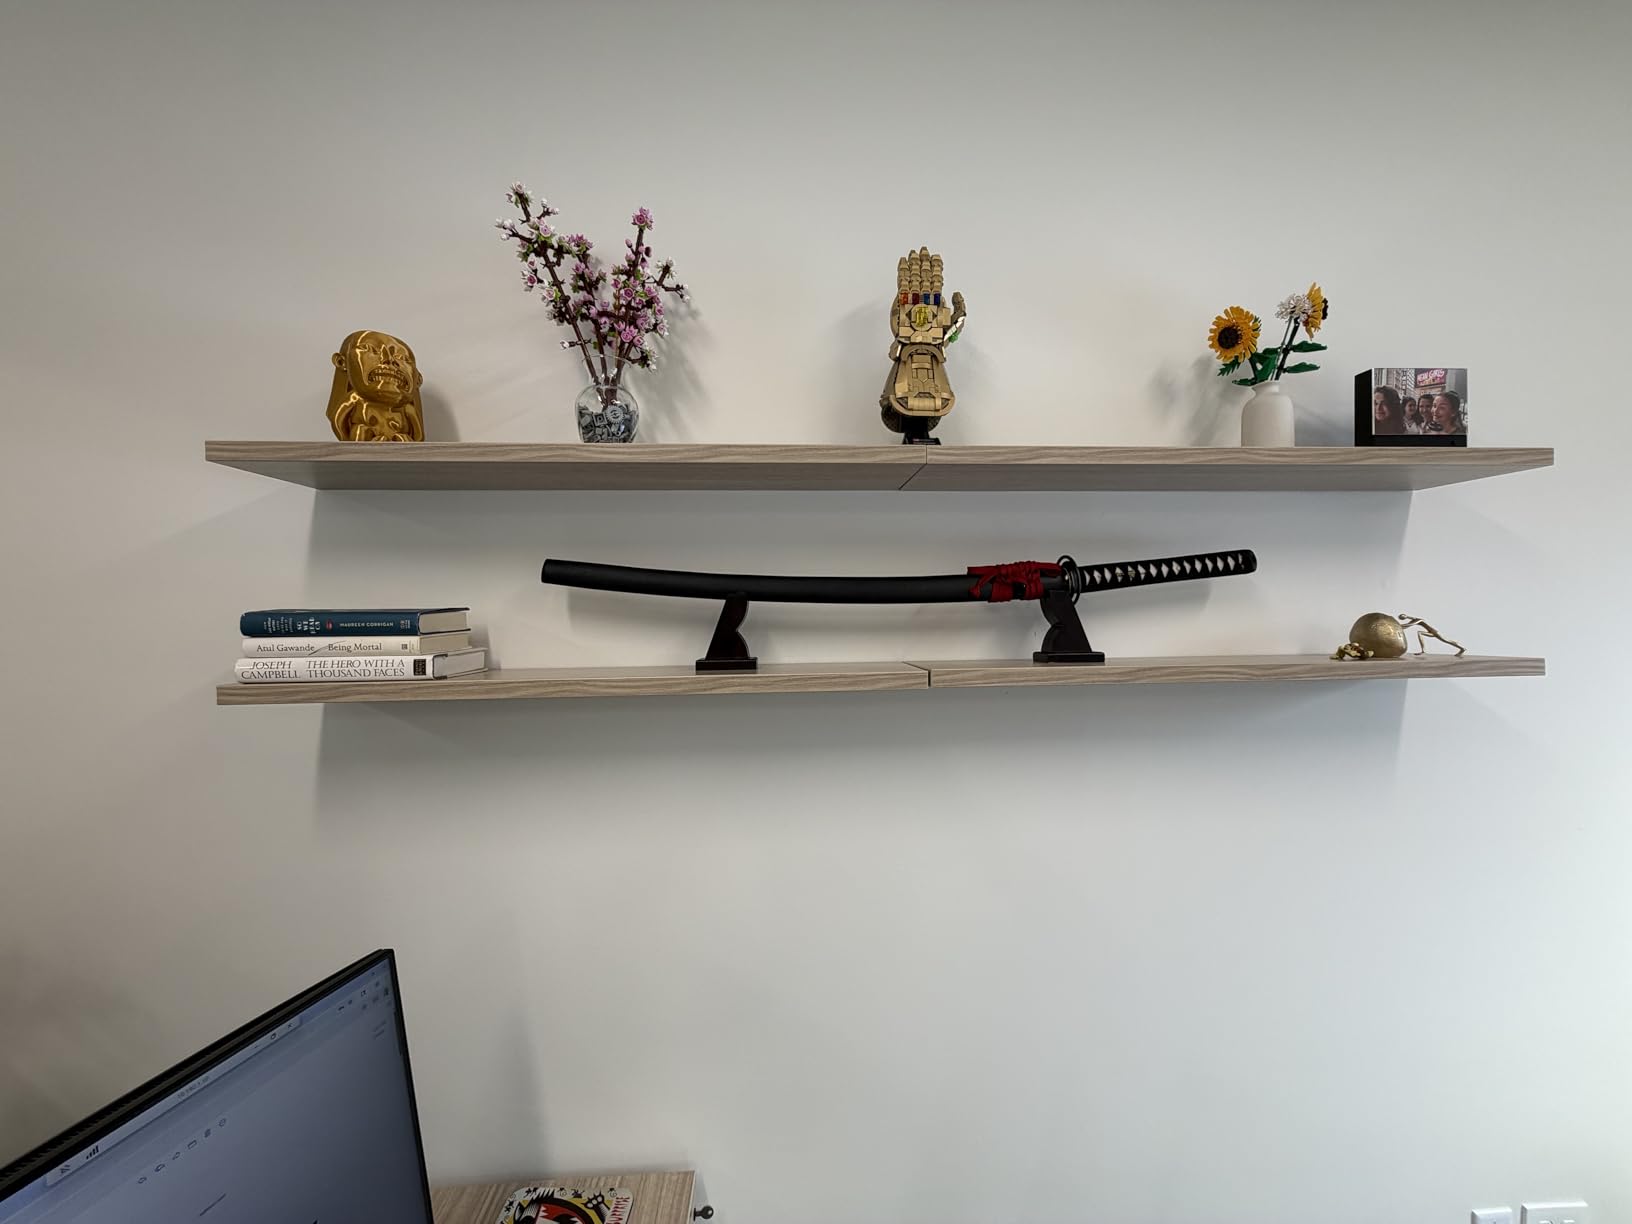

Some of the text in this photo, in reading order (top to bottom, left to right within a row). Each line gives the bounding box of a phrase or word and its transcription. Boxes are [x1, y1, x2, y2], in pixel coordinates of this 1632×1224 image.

[256, 643, 315, 652] Atul Gawande
[328, 642, 382, 652] Being Mortal
[251, 661, 292, 670] JOSEPH
[306, 660, 329, 668] THE
[331, 659, 361, 669] HERO
[364, 659, 396, 668] WITH
[398, 659, 405, 668] A
[241, 670, 300, 679] CAMPBELL
[306, 668, 405, 678] THOUSAND FACES
